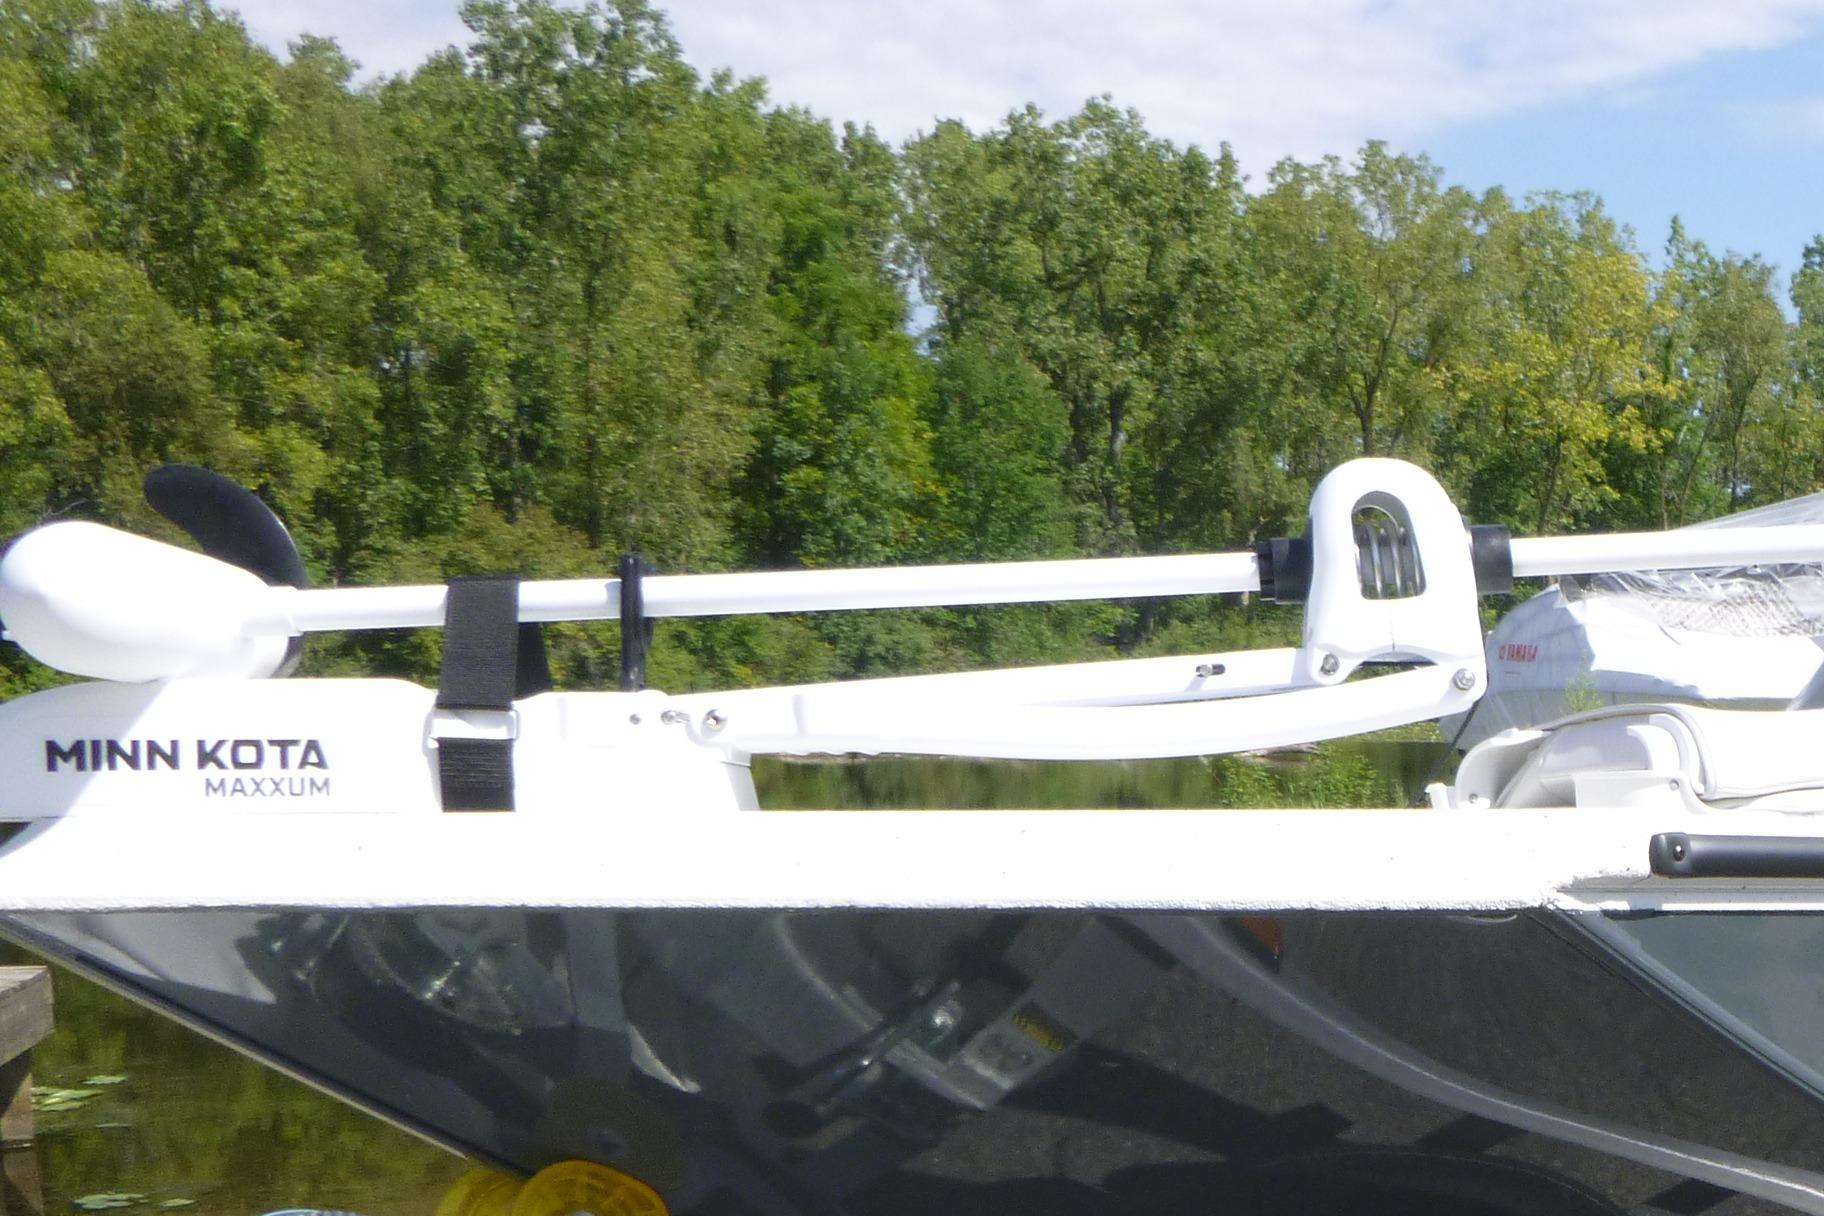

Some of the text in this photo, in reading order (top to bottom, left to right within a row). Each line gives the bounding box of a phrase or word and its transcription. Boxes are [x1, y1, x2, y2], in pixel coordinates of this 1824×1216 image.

[45, 739, 329, 772] MINN KOTA
[205, 777, 331, 797] MAXXUM
